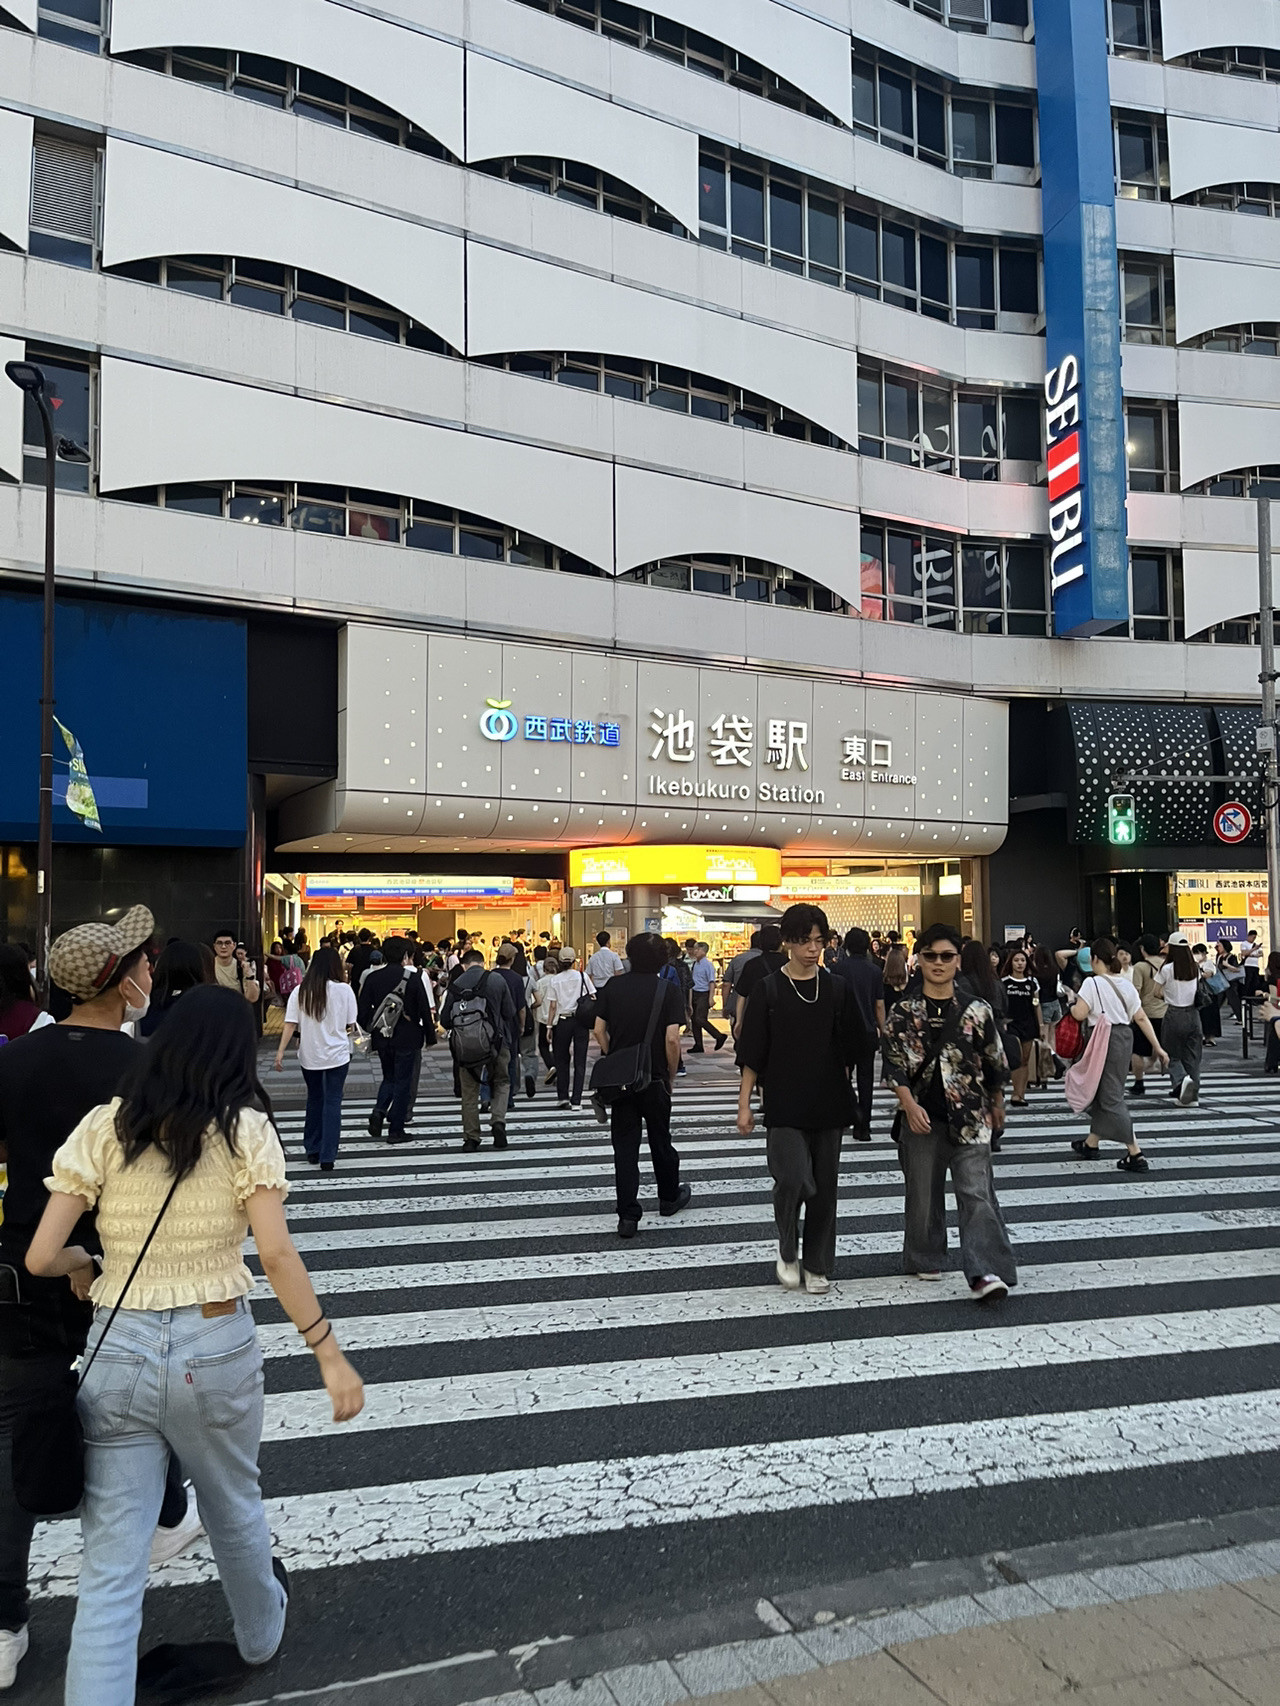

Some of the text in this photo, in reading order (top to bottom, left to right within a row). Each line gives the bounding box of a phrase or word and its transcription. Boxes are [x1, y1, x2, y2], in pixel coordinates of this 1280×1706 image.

[1045, 354, 1085, 596] SEIBU
[523, 715, 621, 747] 西武鉄道
[648, 707, 809, 772] 池袋駅
[841, 735, 894, 768] 東口
[648, 774, 826, 805] Ikebukuro Station
[841, 768, 918, 785] East Entrance
